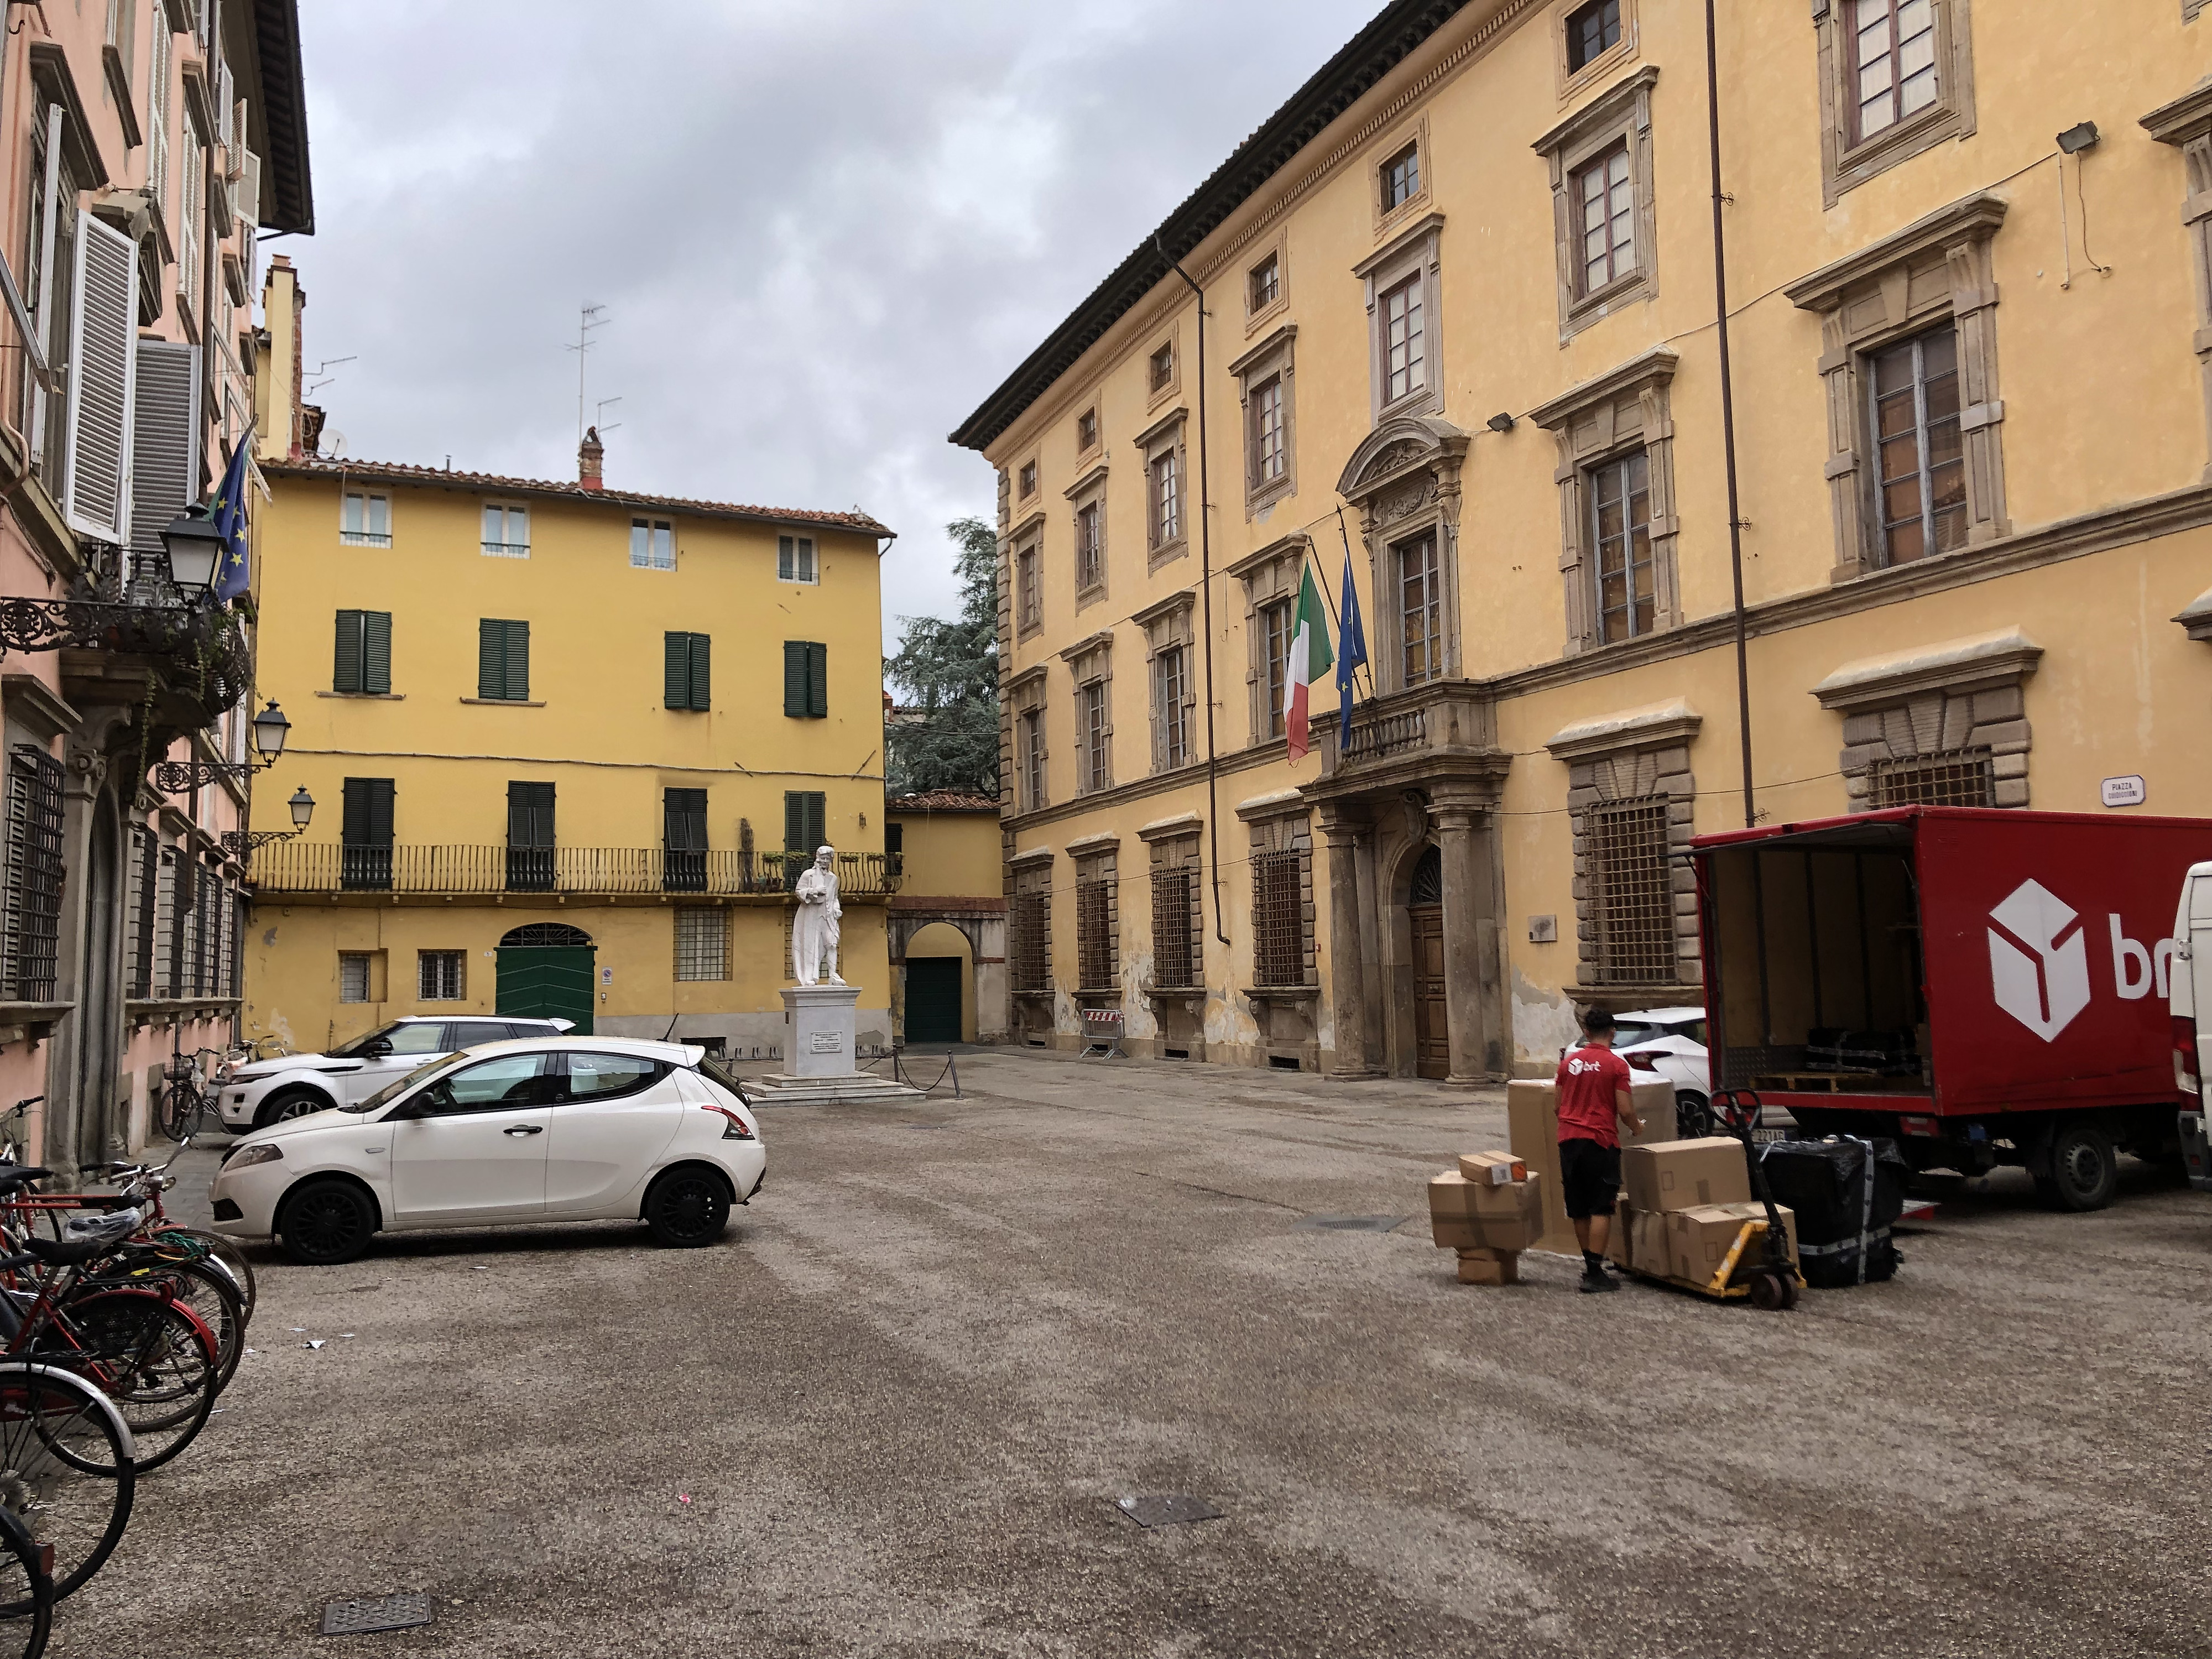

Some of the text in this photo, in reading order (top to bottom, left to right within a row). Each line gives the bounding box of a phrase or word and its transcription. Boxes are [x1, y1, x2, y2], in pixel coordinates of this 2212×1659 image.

[2112, 782, 2132, 791] PIAZZA
[2109, 912, 2173, 1000] br
[1583, 1061, 1601, 1072] brt
